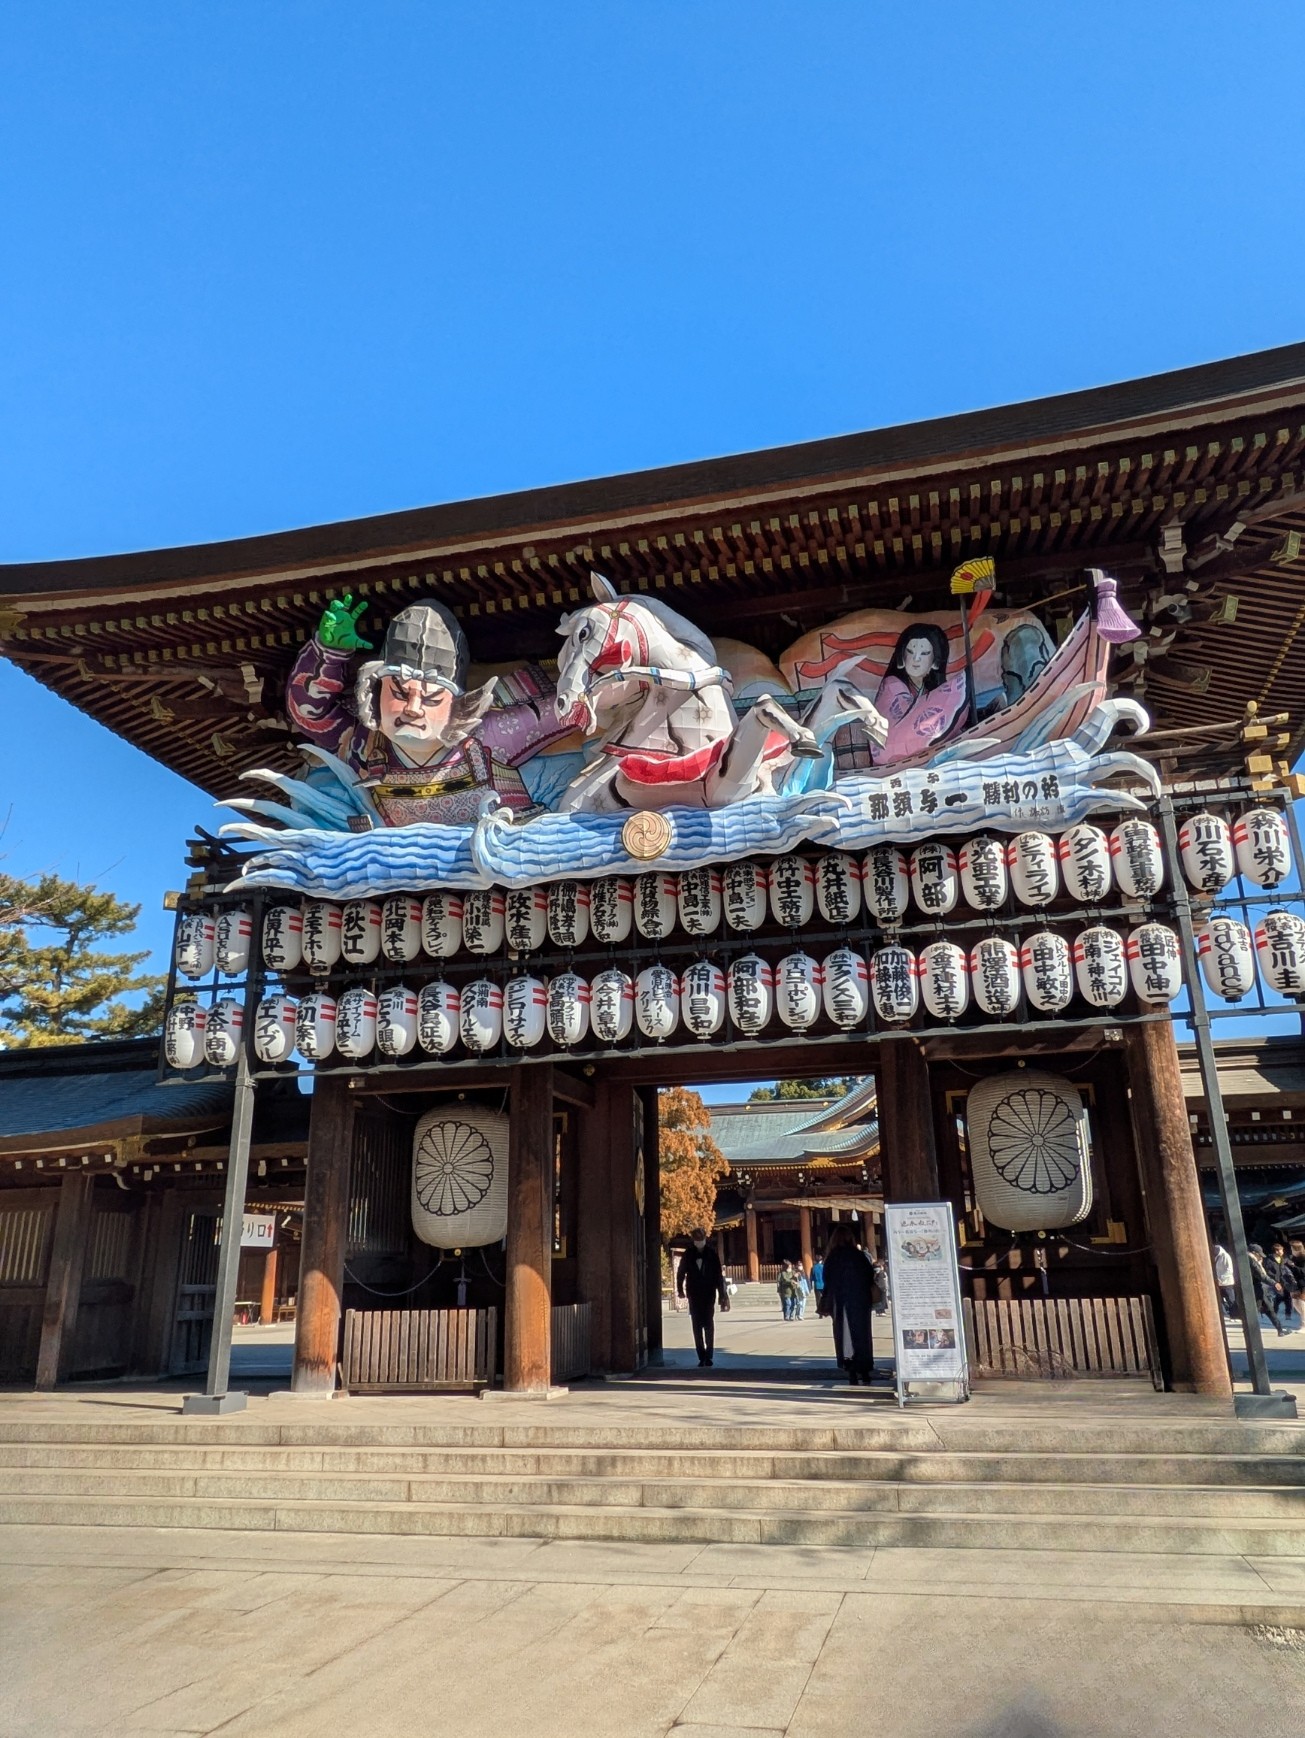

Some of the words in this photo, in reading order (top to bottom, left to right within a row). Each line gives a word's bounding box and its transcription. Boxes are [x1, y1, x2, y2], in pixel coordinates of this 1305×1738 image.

[868, 789, 968, 821] 那須与一
[918, 845, 947, 908] (株)阿部
[1019, 834, 1052, 902] (株)シティライフ
[1249, 811, 1285, 882] 森川栄介
[1213, 921, 1245, 996] advance
[179, 1005, 195, 1031] 中野
[733, 961, 762, 1029] 阿部和彦
